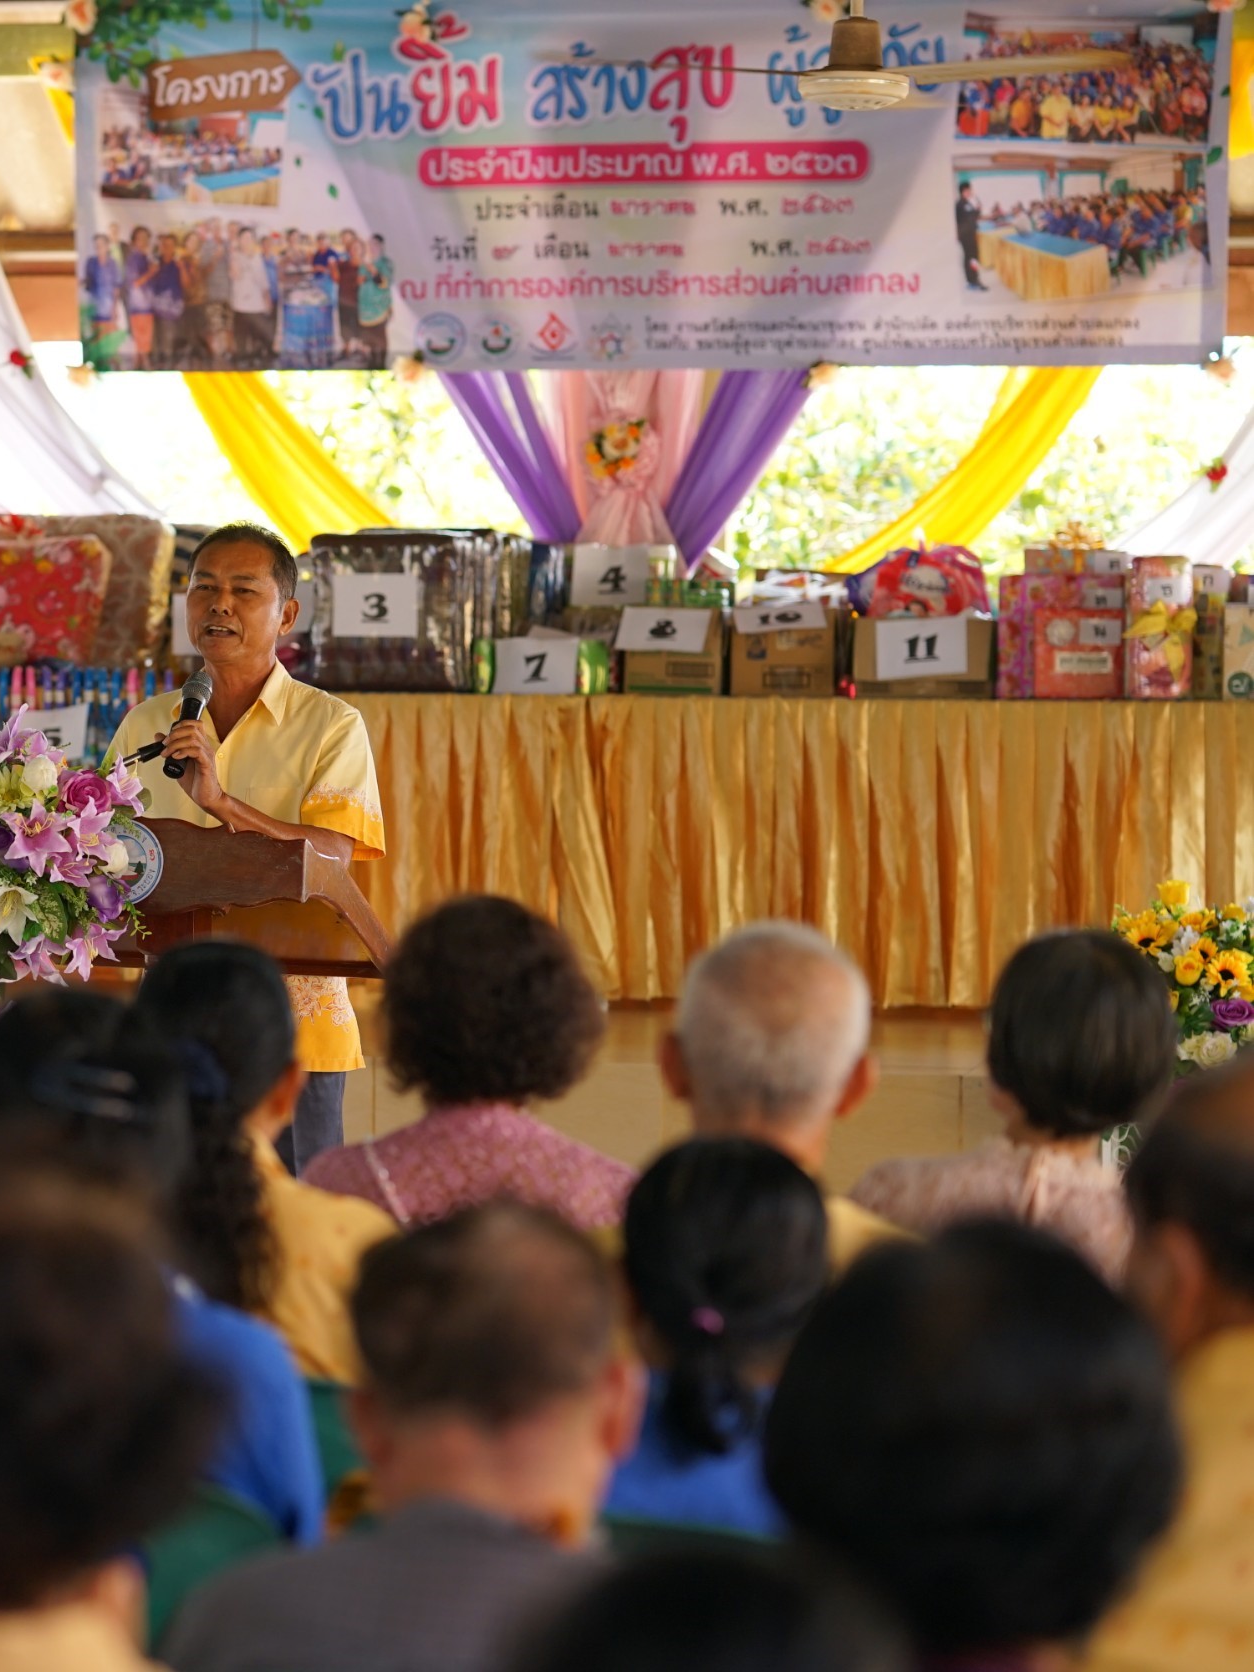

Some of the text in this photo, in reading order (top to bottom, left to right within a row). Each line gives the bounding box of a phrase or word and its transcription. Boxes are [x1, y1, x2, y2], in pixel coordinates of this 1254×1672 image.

[150, 63, 290, 108] โครงการ
[311, 12, 500, 139] ปันยิ้ม
[531, 41, 735, 143] สร้างสุข
[427, 148, 859, 182] ประจำปีงบประมาณ พ.ศ. ๒๕๖๓
[475, 193, 600, 221] ประจำเดือน
[719, 199, 769, 216] พ.ศ.
[430, 229, 478, 262] วันที่
[534, 234, 590, 260] เดือน
[750, 240, 800, 257] พ.ศ.
[399, 265, 921, 300] ณ ที่ทำการองค์การบริหารส่วนตำบลแกลง
[599, 564, 627, 589] 4
[362, 592, 388, 619] 3
[905, 634, 939, 659] 11
[524, 653, 547, 681] 7
